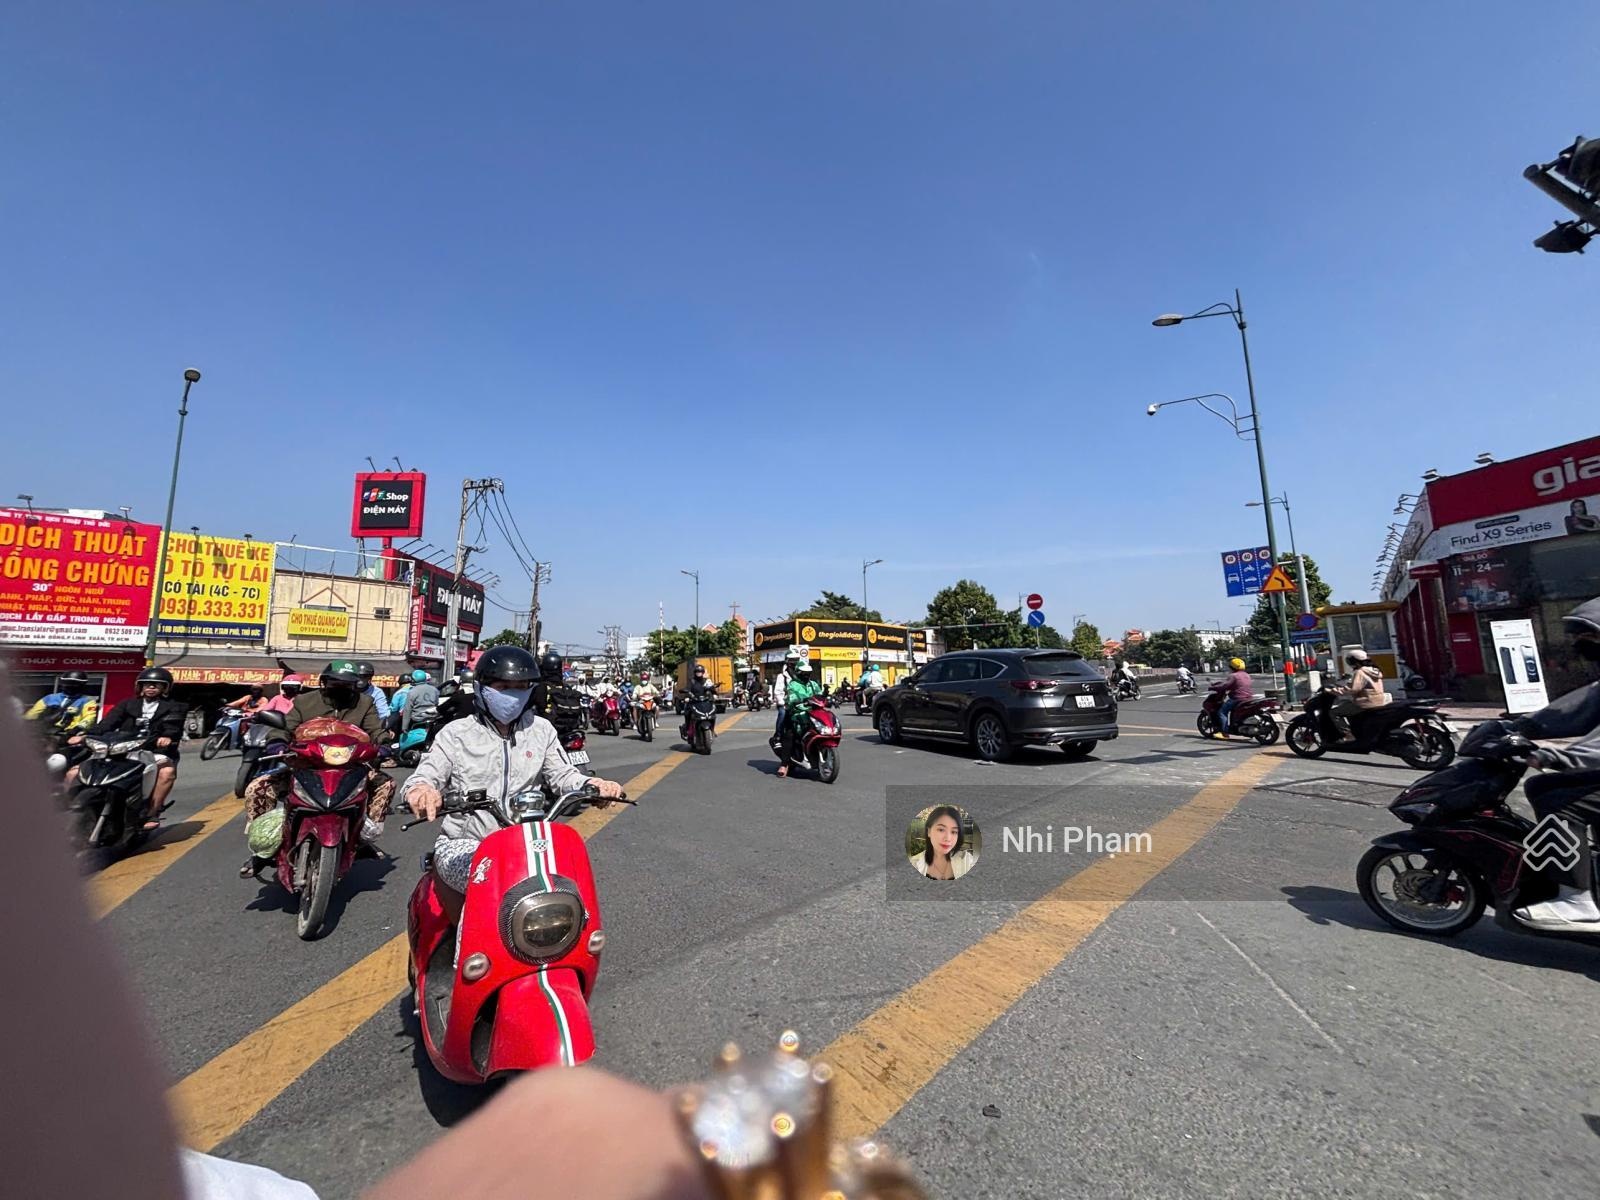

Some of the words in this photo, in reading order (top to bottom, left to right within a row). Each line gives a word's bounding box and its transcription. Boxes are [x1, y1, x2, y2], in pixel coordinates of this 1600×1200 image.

[386, 492, 409, 502] Shop
[363, 505, 386, 516] ĐIỆN
[387, 505, 407, 514] MÁY
[0, 523, 62, 552] DỊCH
[73, 529, 147, 560] THUẬT
[1451, 533, 1480, 547] Find
[1482, 528, 1502, 541] X9
[1505, 521, 1552, 537] Series
[0, 550, 60, 581] ÔNG
[66, 559, 150, 587] CHỨNG
[181, 557, 205, 578] TÔ
[240, 563, 268, 583] LÁI
[164, 579, 182, 593] CÓ
[186, 580, 206, 596] TÀI
[462, 594, 482, 615] MÁY
[818, 631, 863, 640] thegioididong
